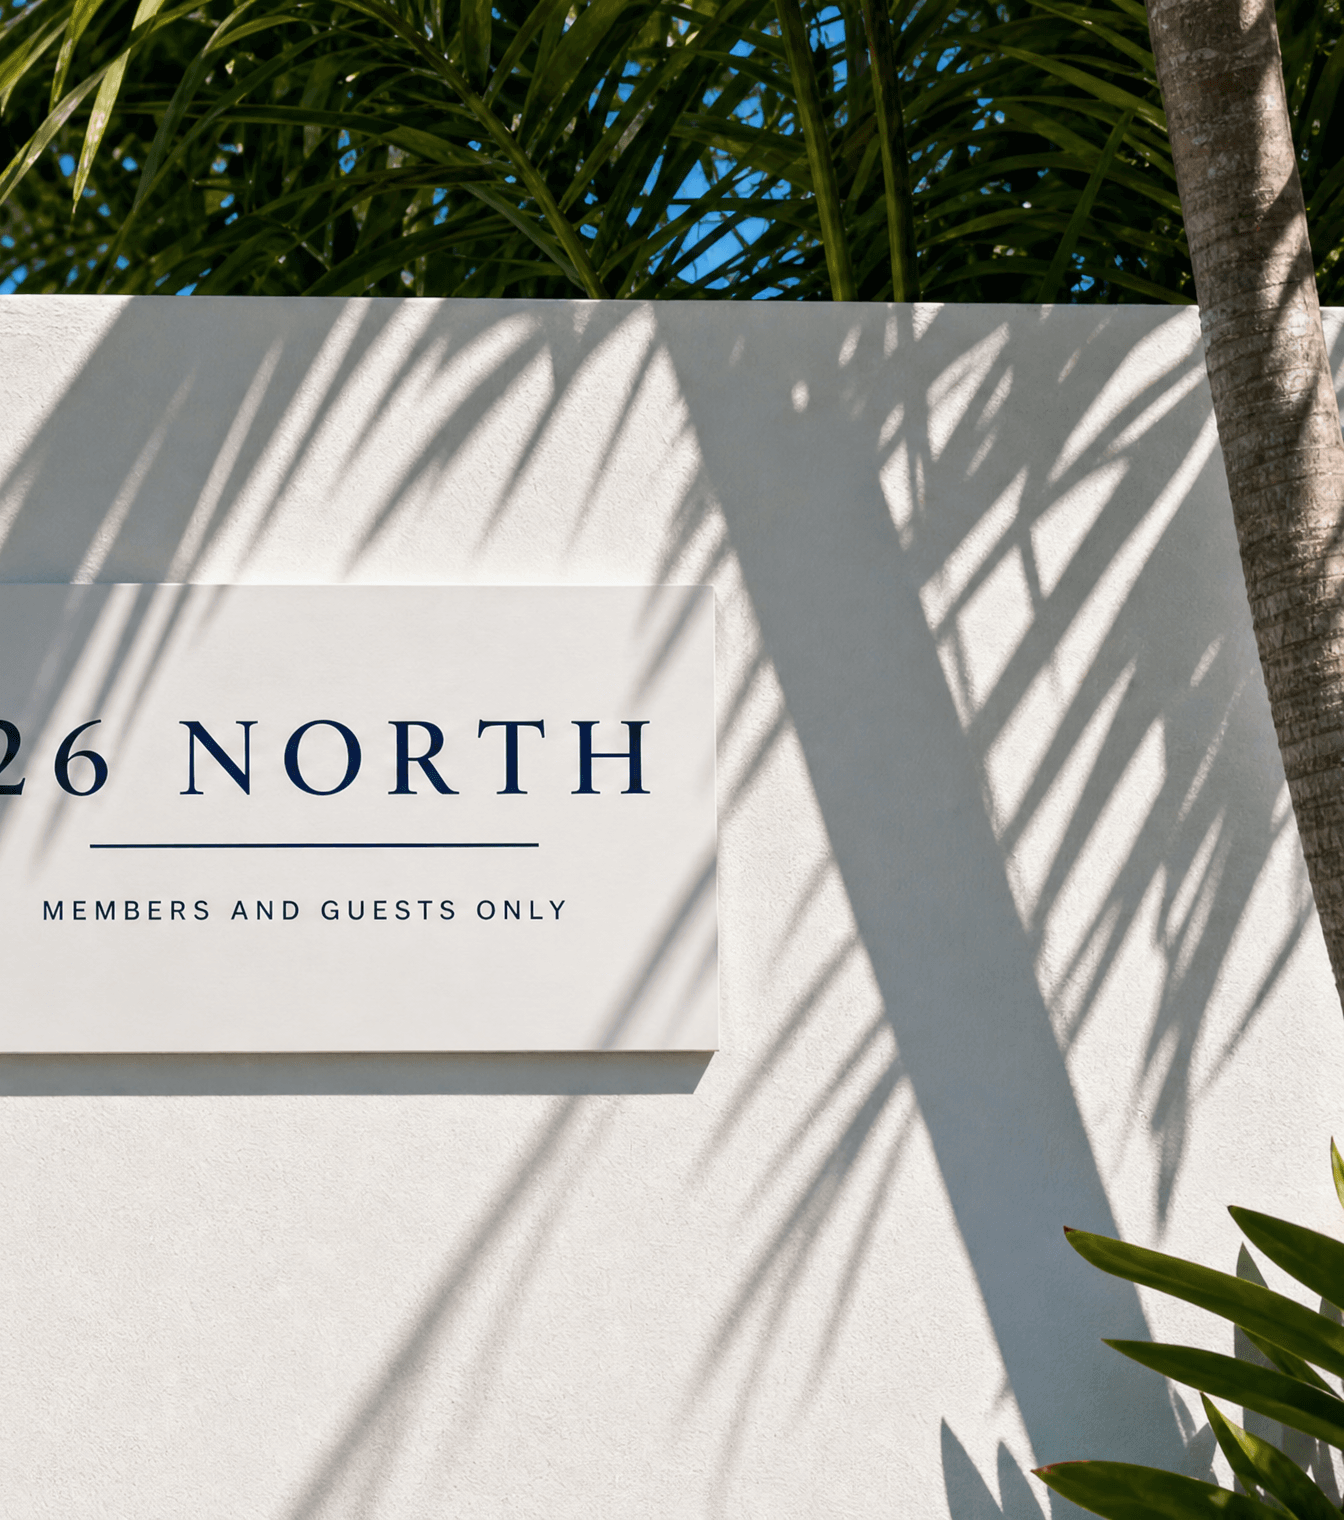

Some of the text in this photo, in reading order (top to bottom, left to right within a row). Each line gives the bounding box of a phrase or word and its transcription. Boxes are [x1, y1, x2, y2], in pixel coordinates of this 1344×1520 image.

[178, 718, 653, 797] NORTH
[42, 898, 568, 921] MEMBERS AND GUESTS ONLY
